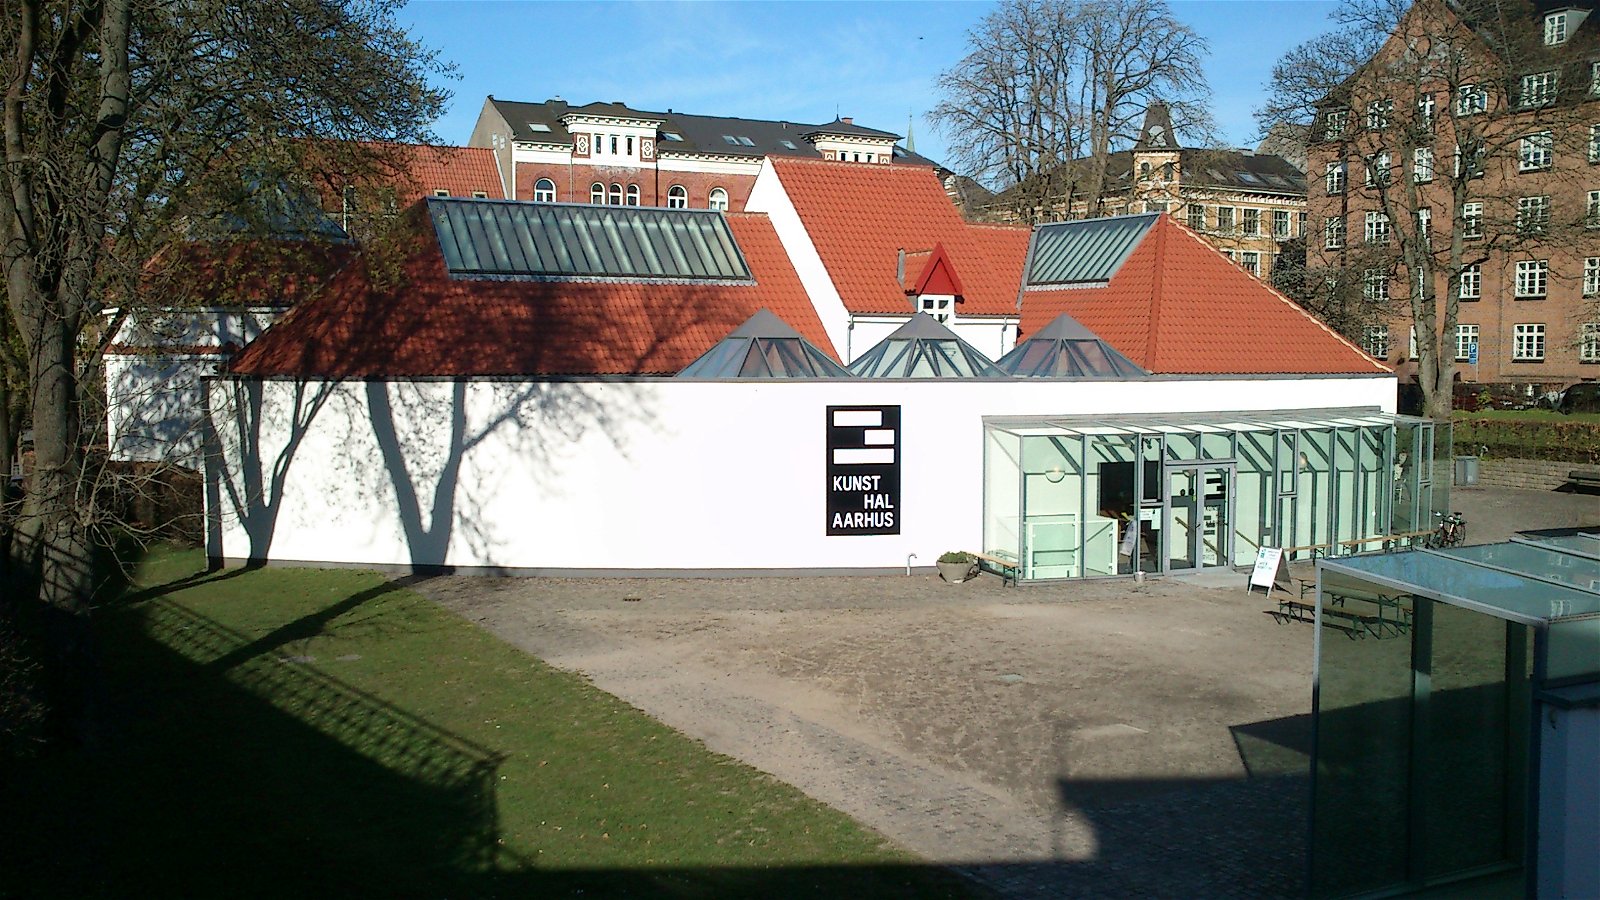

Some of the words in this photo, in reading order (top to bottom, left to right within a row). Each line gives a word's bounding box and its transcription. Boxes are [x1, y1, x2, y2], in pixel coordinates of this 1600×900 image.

[833, 475, 881, 491] KUNST
[864, 493, 894, 509] HAL
[832, 512, 894, 528] AARHUS
